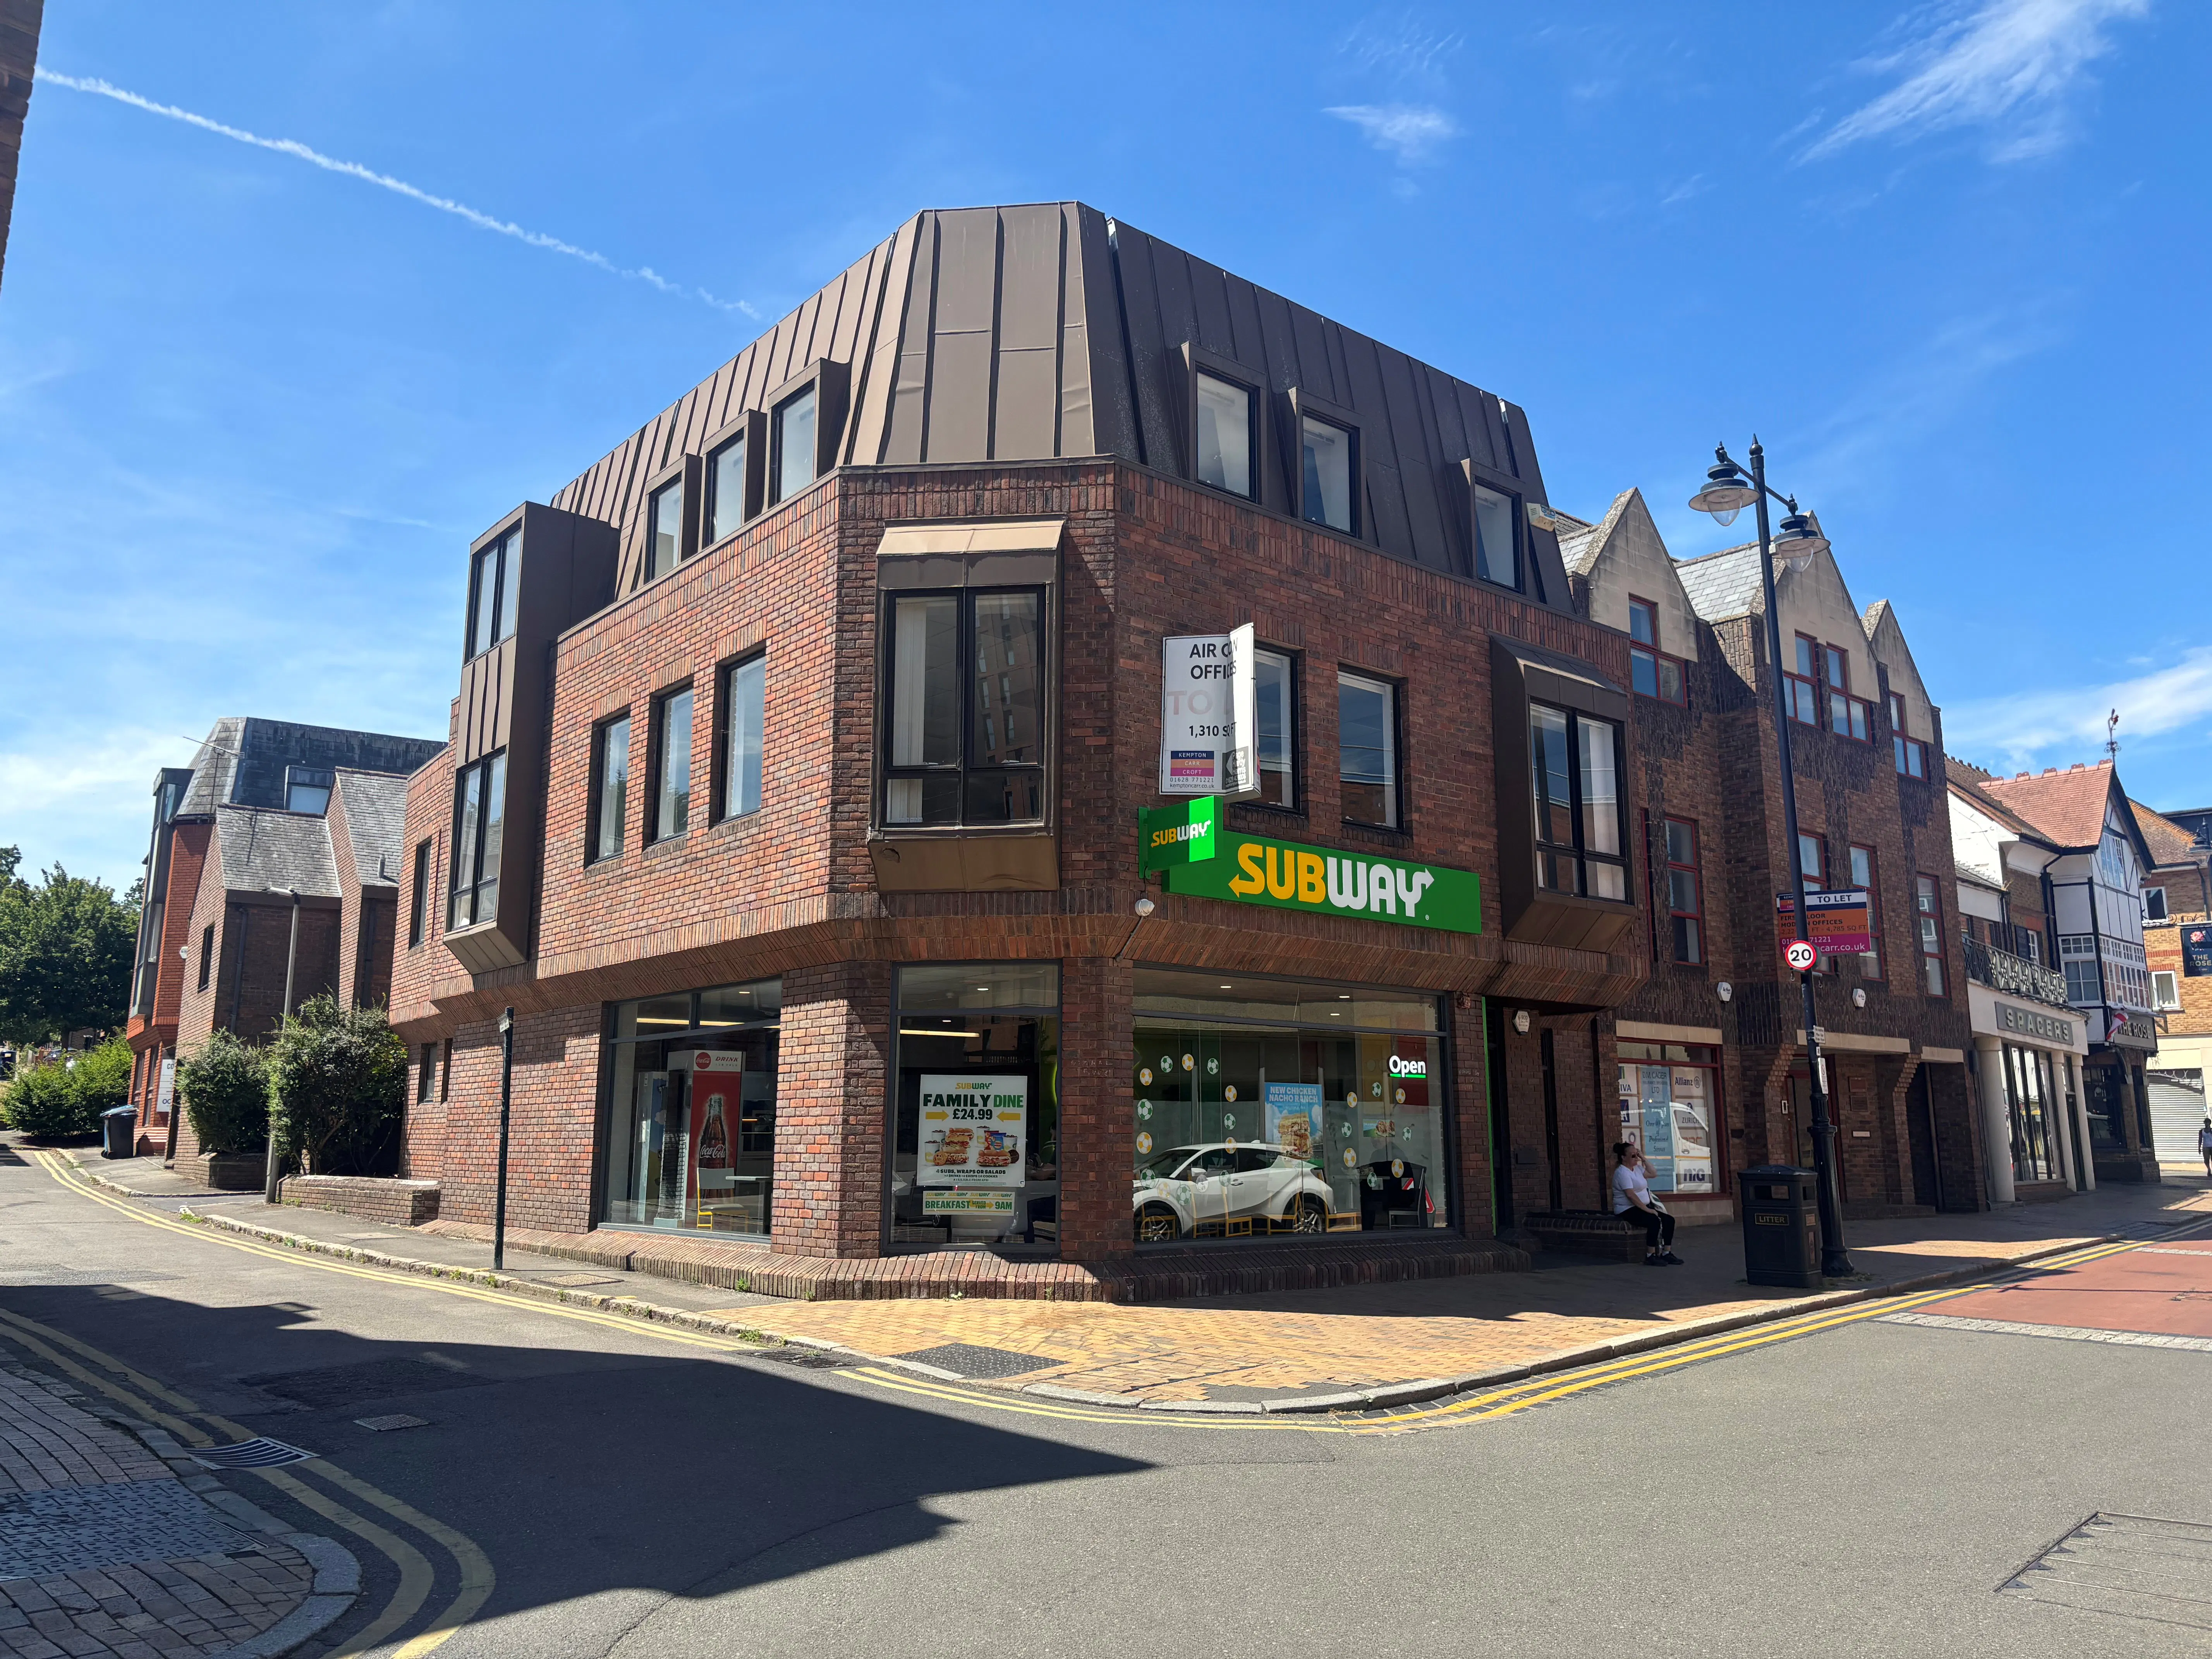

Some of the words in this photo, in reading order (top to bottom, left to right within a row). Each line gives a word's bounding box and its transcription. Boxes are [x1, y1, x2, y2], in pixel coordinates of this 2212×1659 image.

[1190, 643, 1217, 658] AIR
[1221, 637, 1238, 658] CON
[1190, 660, 1237, 679] OFFICES
[1189, 725, 1219, 738] 1,310
[1223, 725, 1230, 737] SQ
[1231, 721, 1237, 735] FT
[1151, 819, 1211, 848] SUBWAY
[1228, 843, 1435, 918] SUBWAY
[1790, 949, 1812, 962] 20
[2006, 1008, 2069, 1041] SPACERS
[2119, 1022, 2132, 1036] THE
[2133, 1022, 2151, 1039] ROSE
[1389, 1055, 1426, 1077] Open
[1675, 1077, 1693, 1086] Allianz
[923, 1094, 991, 1108] FAMILY
[994, 1095, 1024, 1108] DINE
[952, 1108, 993, 1120] £24.99
[925, 1200, 970, 1209] BREAKFAST
[995, 1201, 1012, 1210] 9AM
